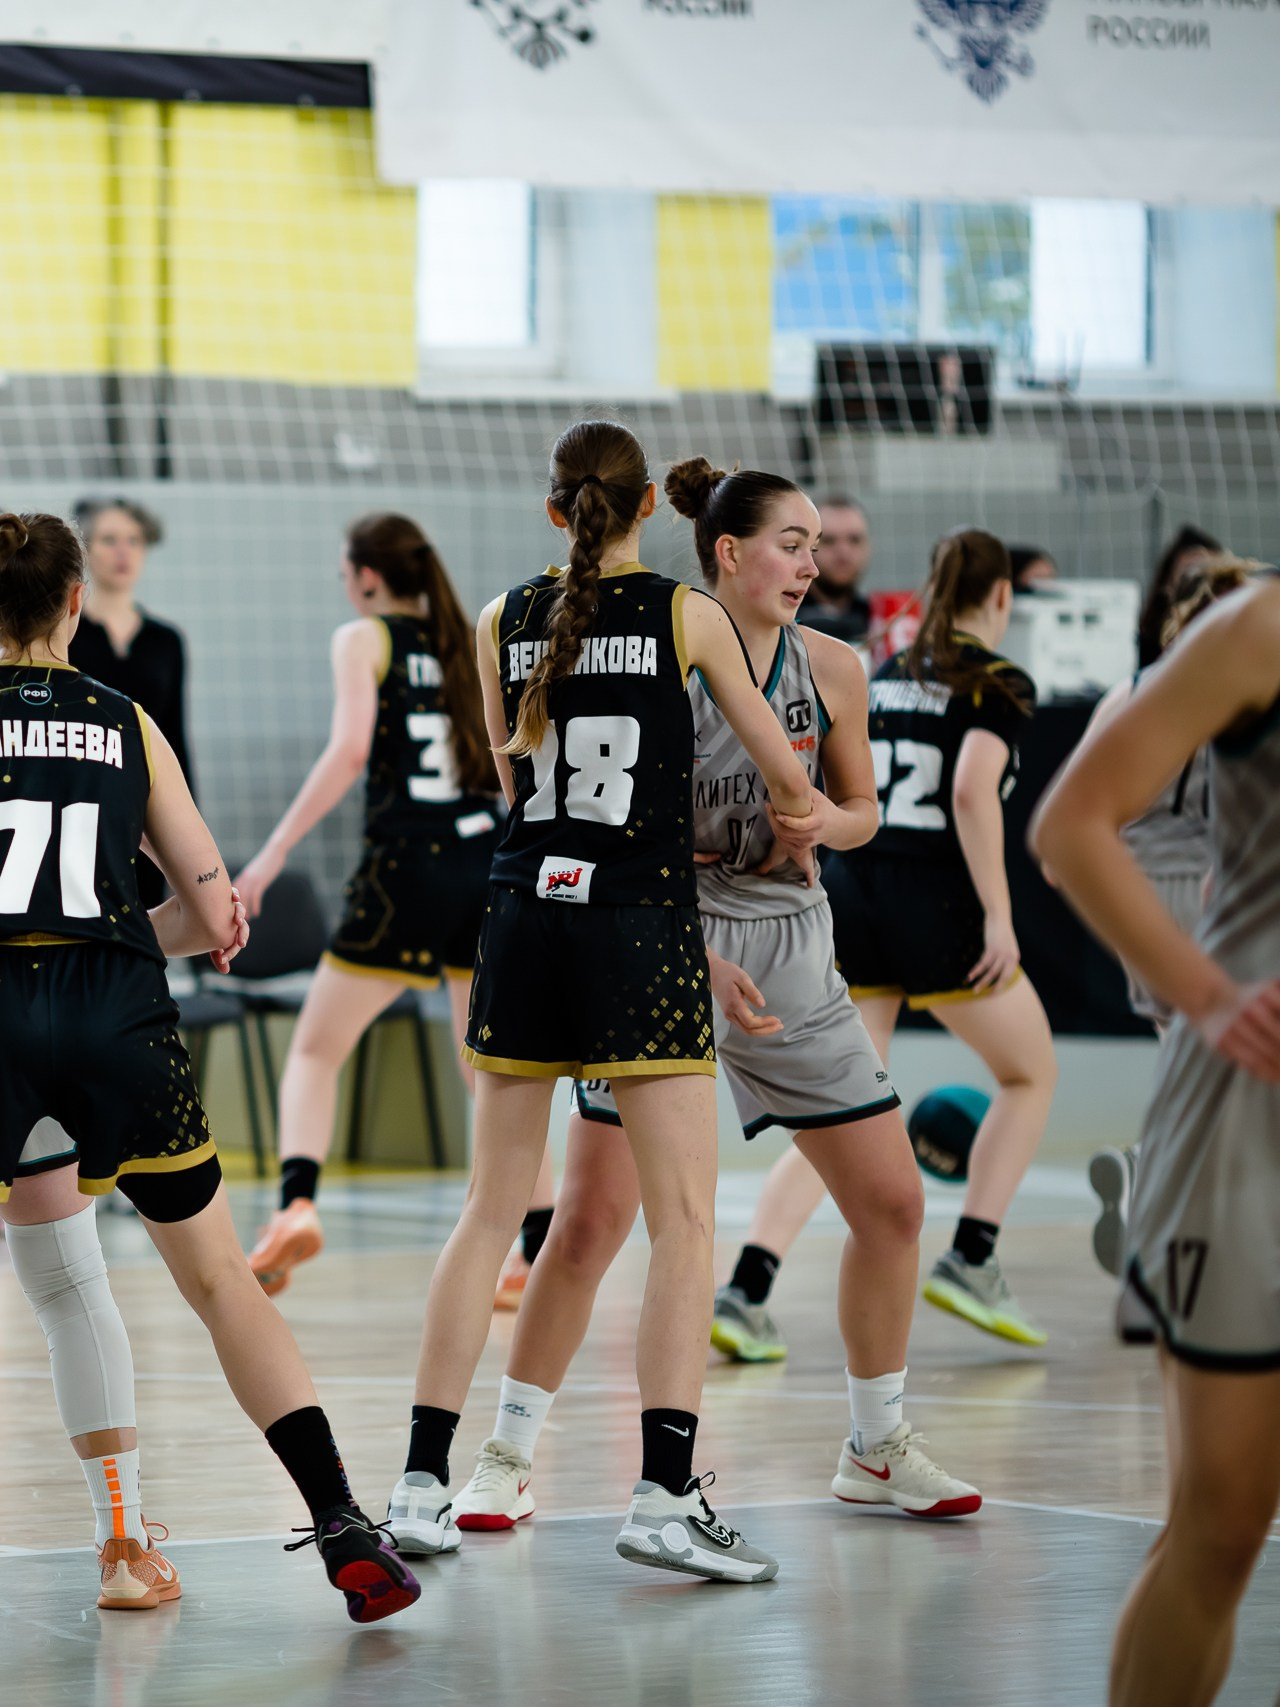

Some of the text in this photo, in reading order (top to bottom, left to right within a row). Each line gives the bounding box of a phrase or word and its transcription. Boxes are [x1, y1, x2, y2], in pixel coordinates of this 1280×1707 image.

[1086, 14, 1211, 50] РОССИИ
[23, 689, 49, 698] РФБ
[523, 715, 641, 826] 18
[545, 867, 584, 892] NRJ
[1167, 1238, 1209, 1322] 17
